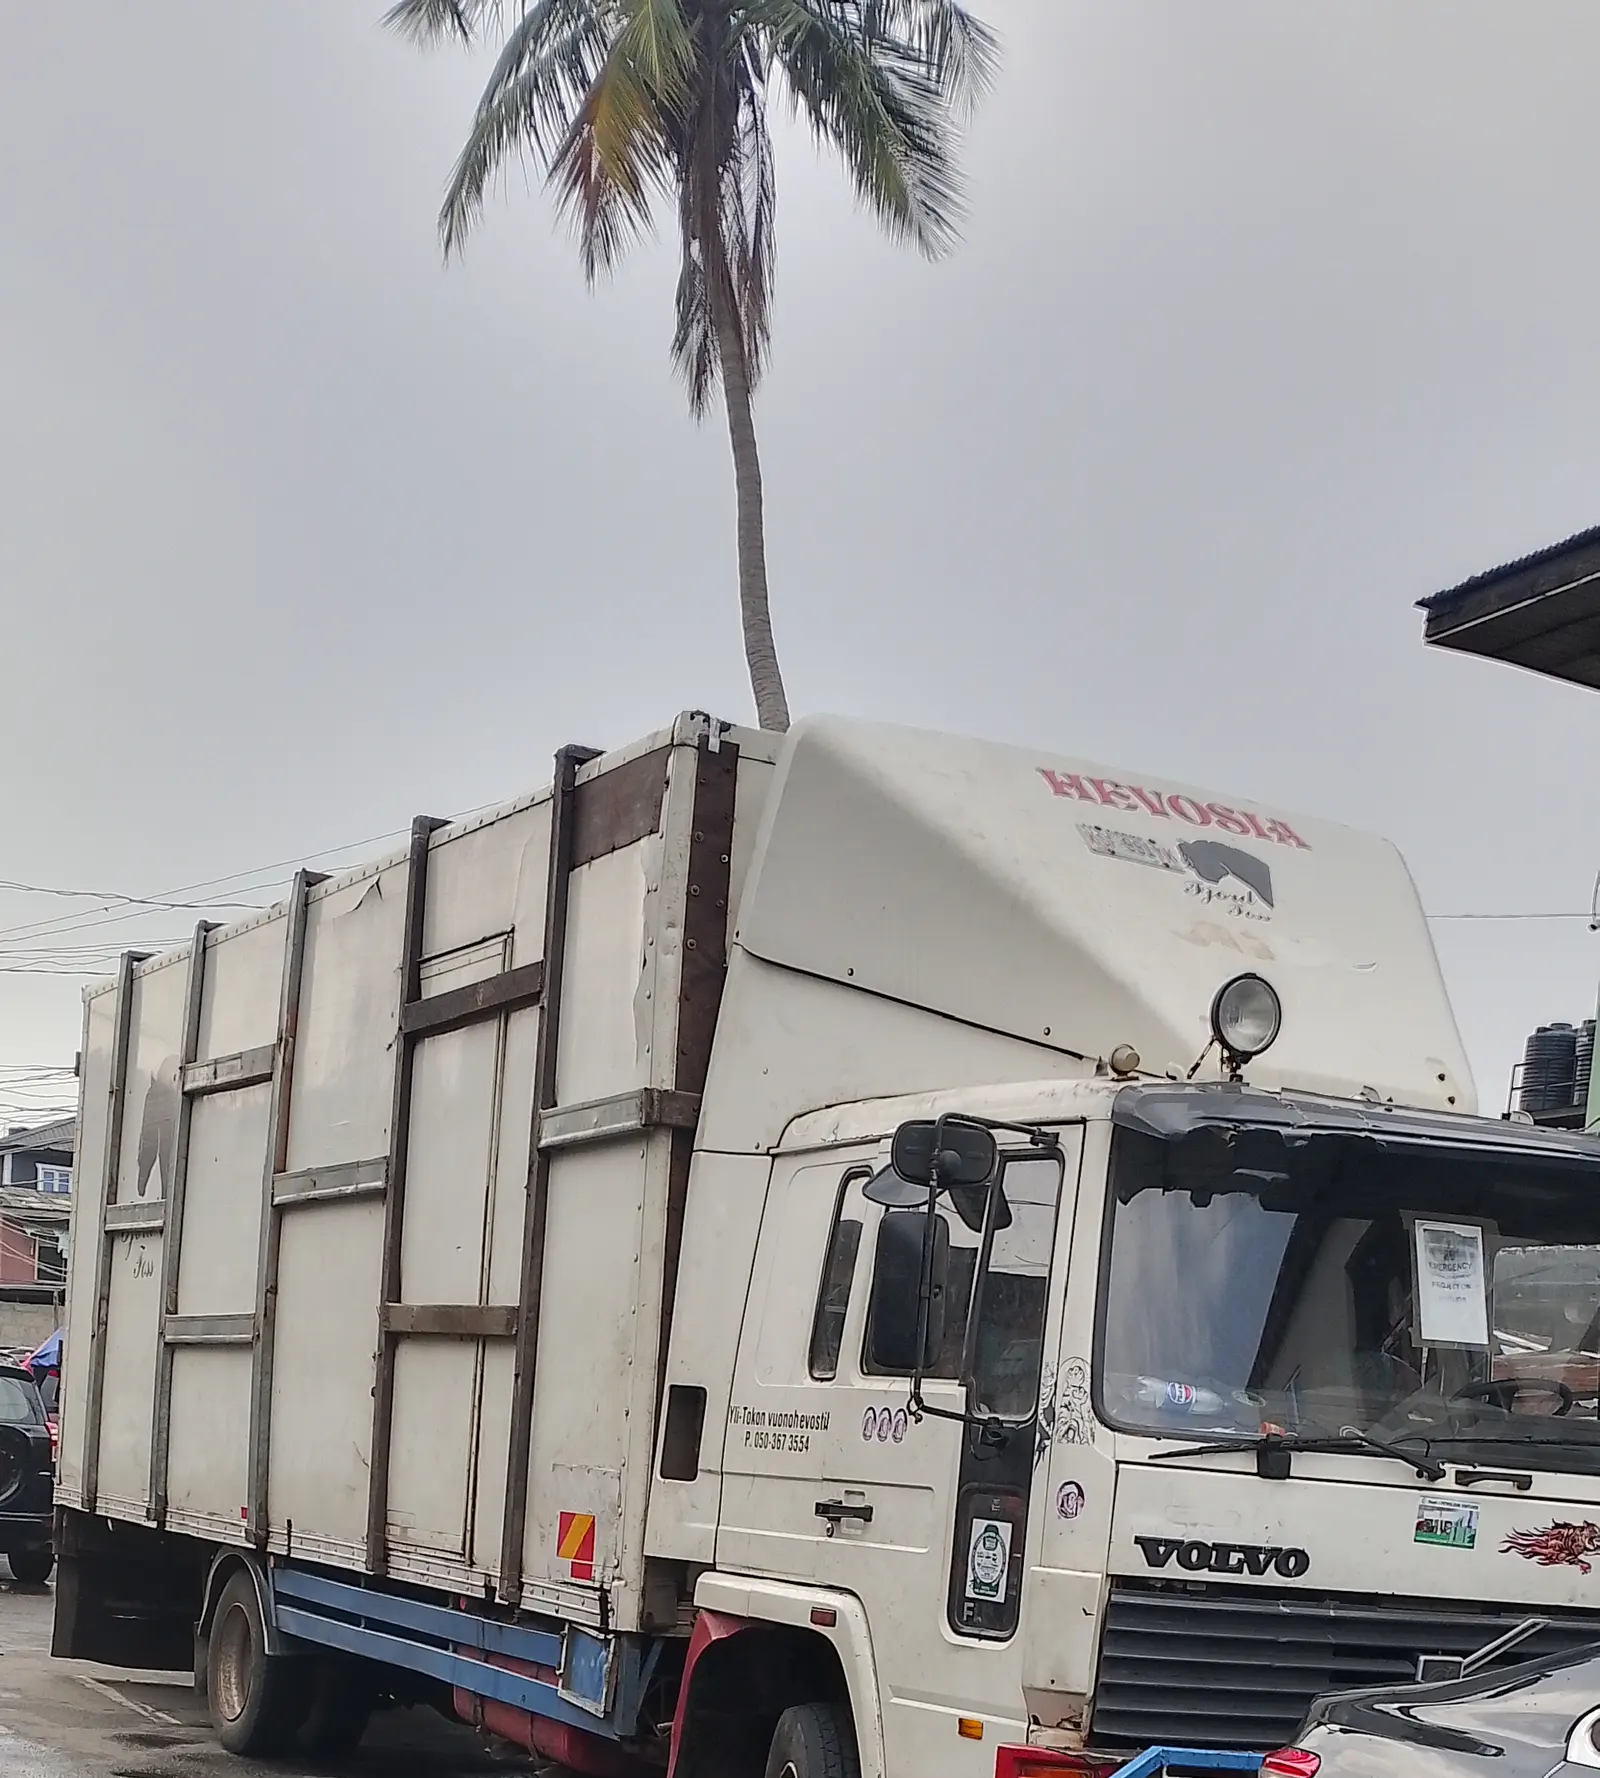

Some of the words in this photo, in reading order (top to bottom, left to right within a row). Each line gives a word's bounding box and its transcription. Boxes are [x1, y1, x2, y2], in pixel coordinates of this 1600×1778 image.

[1034, 766, 1312, 851] HEVOSIA
[754, 1432, 787, 1450] 050-367
[788, 1434, 810, 1452] 3554
[1134, 1535, 1310, 1578] VOLVO
